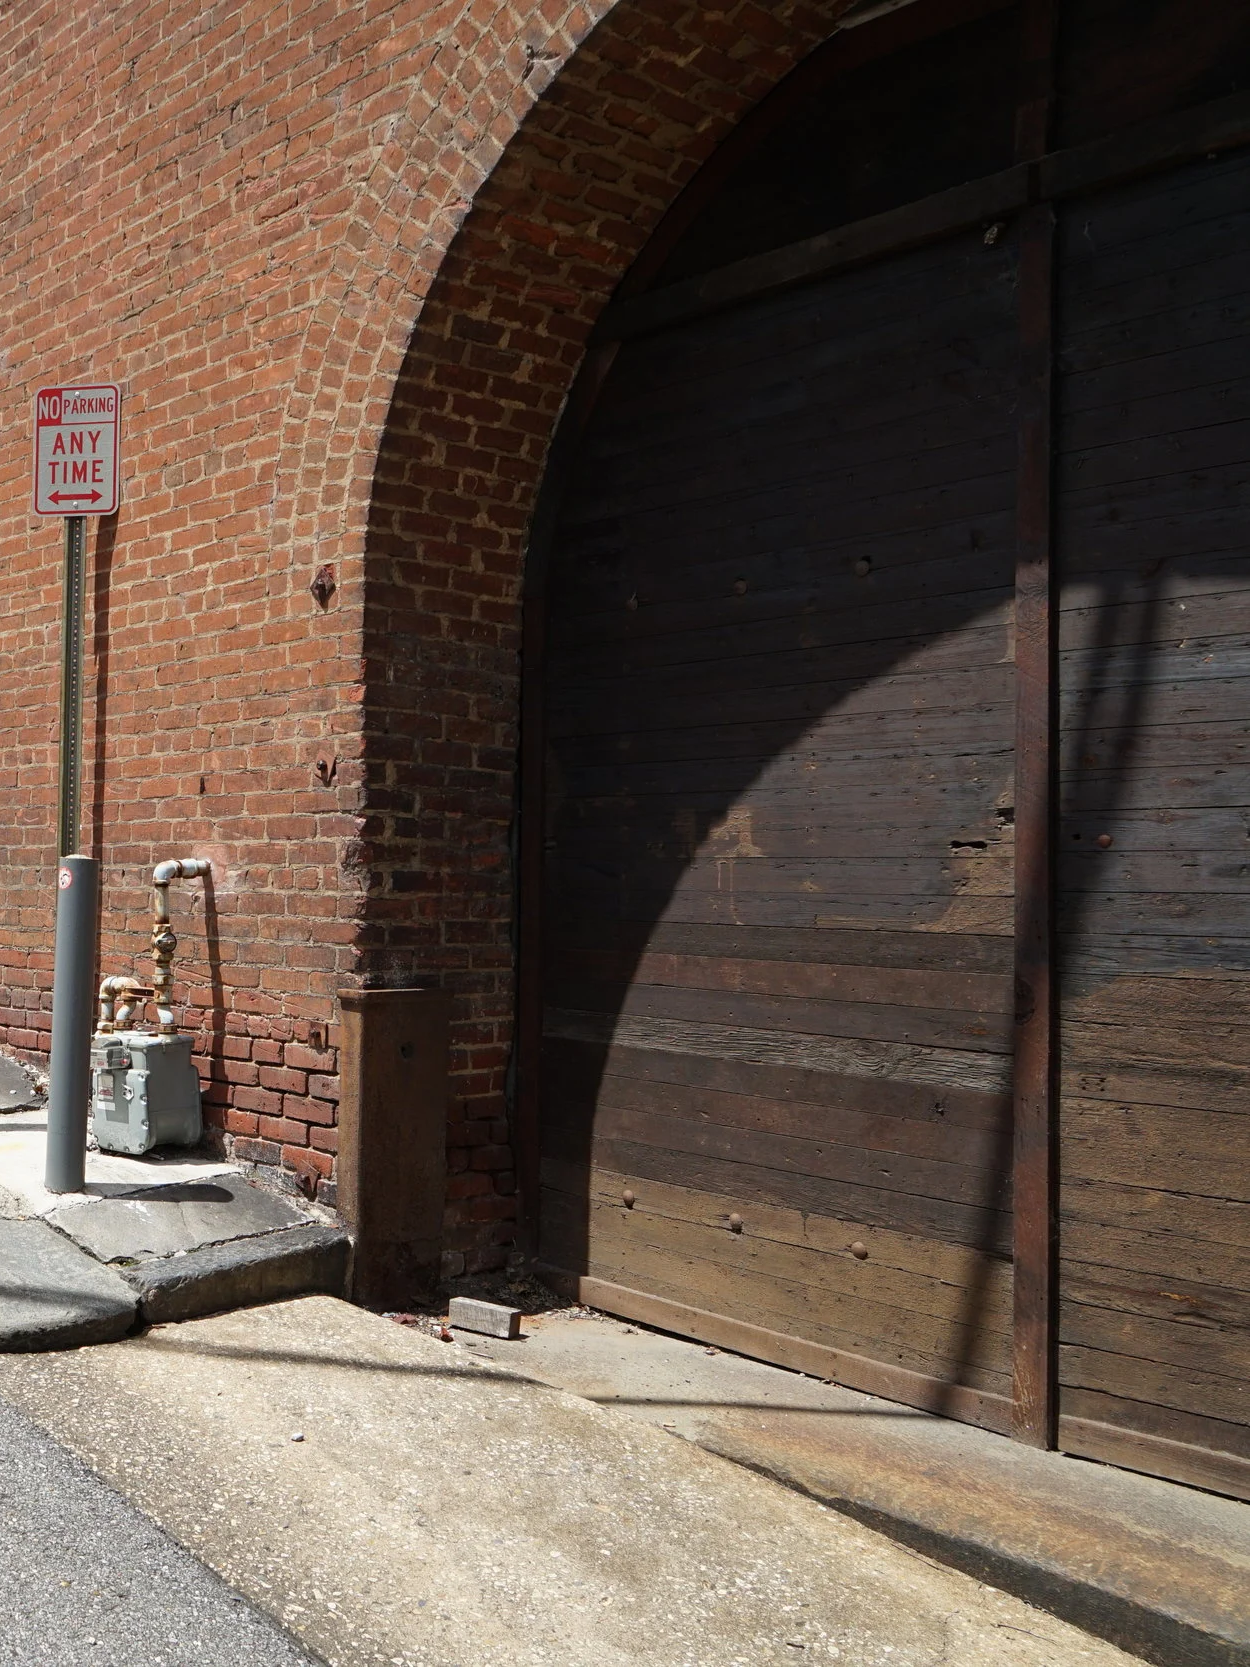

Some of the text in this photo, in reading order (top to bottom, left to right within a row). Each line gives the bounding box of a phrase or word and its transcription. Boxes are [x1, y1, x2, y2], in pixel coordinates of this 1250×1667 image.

[38, 396, 114, 420] NO PARKING
[52, 430, 102, 455] ANY
[48, 459, 104, 484] TIME
